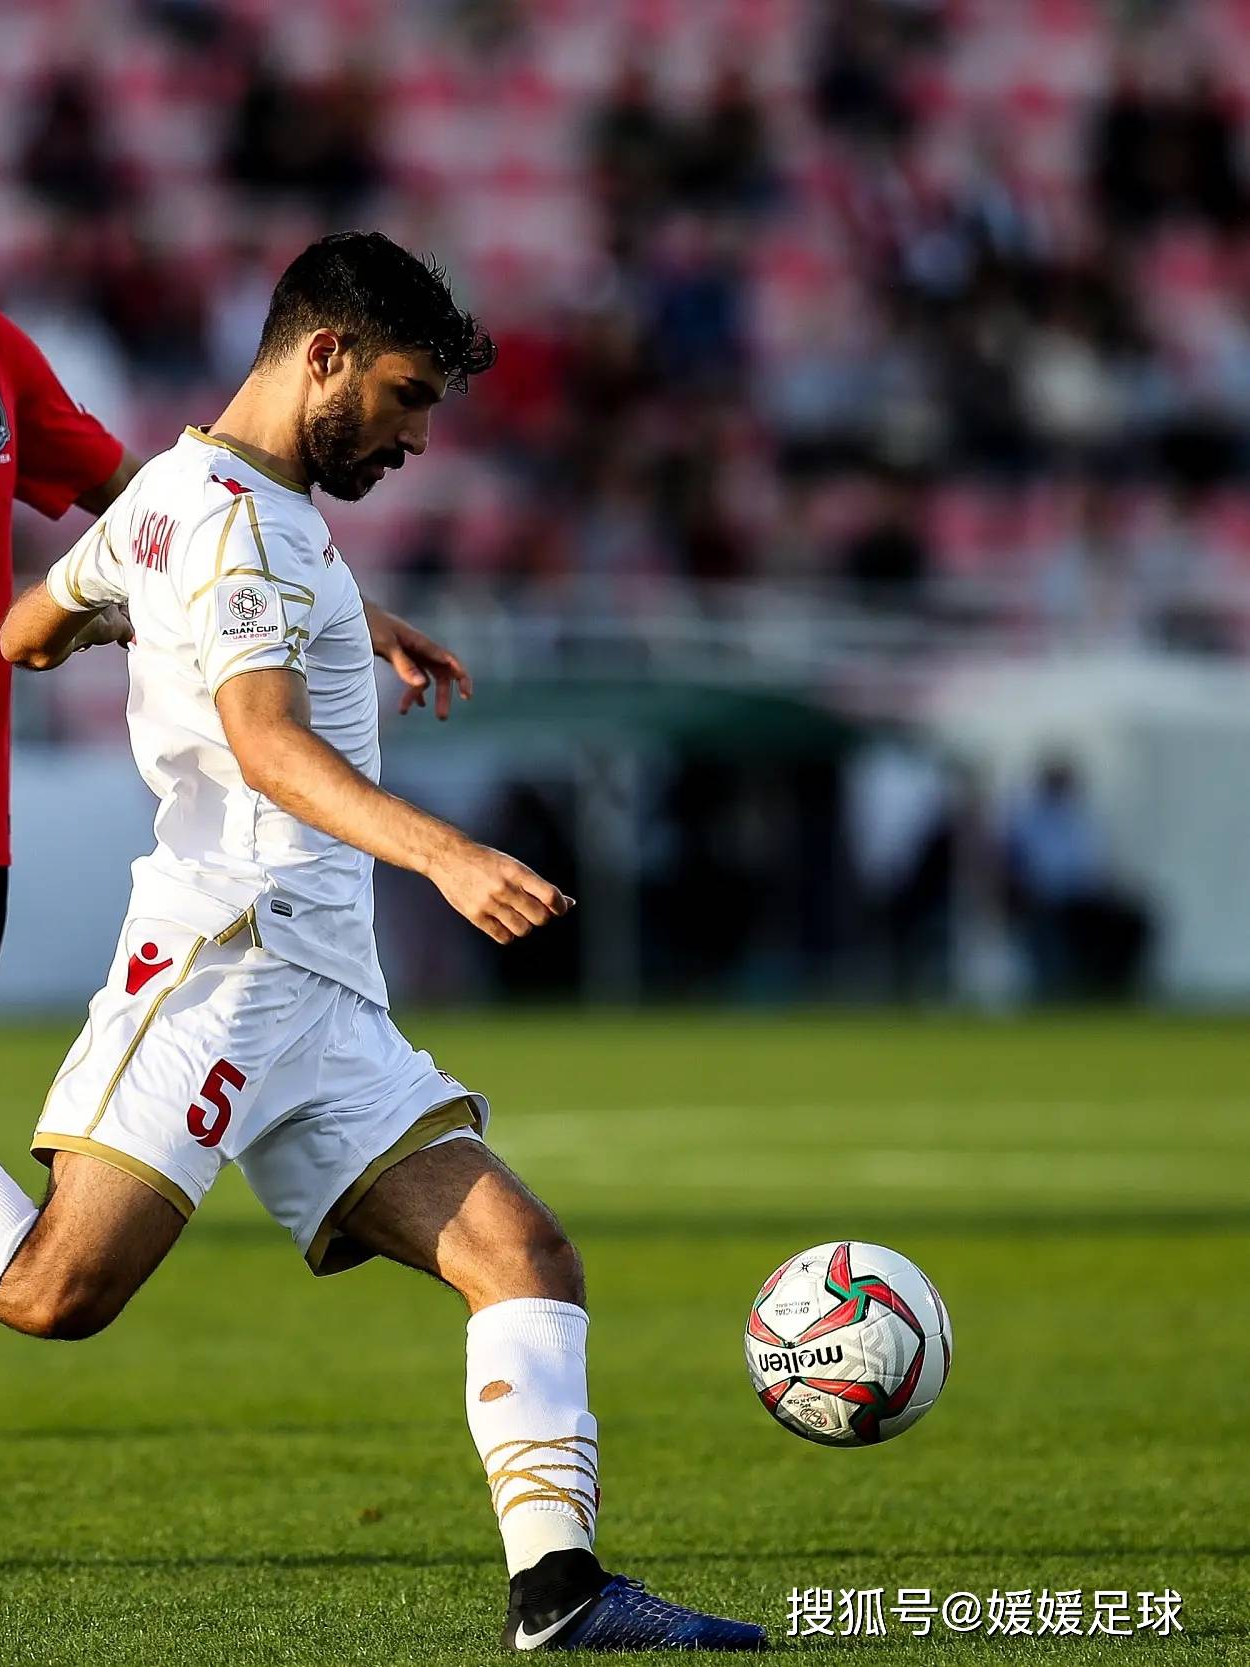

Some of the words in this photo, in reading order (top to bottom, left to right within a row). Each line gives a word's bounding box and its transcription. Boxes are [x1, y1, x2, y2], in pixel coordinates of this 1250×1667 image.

[222, 627, 254, 636] ASIAN
[256, 625, 279, 633] CUP
[187, 1058, 247, 1148] 5
[759, 1345, 844, 1374] molten
